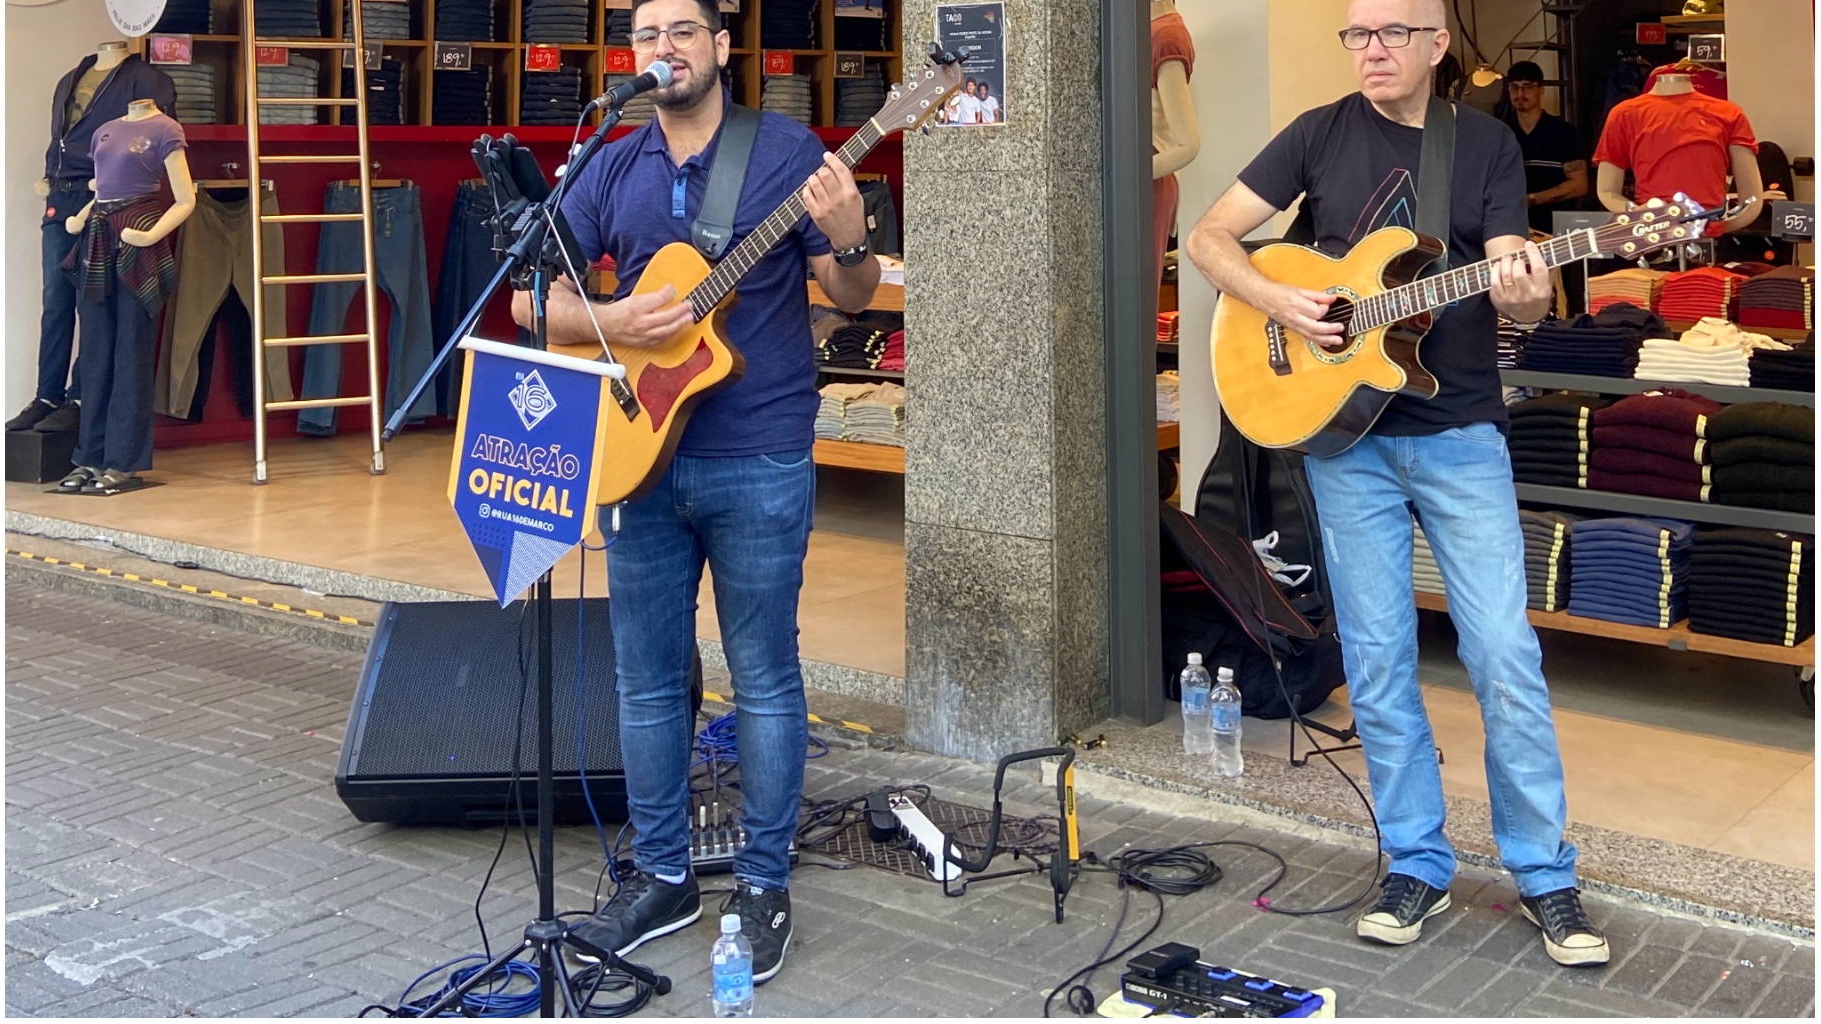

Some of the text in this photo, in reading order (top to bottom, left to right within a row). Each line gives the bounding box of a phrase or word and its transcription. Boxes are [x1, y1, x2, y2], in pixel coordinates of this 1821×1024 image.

[945, 13, 962, 22] TACO
[1632, 221, 1671, 236] CRAFTER
[517, 382, 547, 413] 16
[471, 434, 580, 480] ATRAÇÃO
[468, 468, 573, 518] OFICIAL
[1125, 983, 1168, 1000] BOSS GT-1
